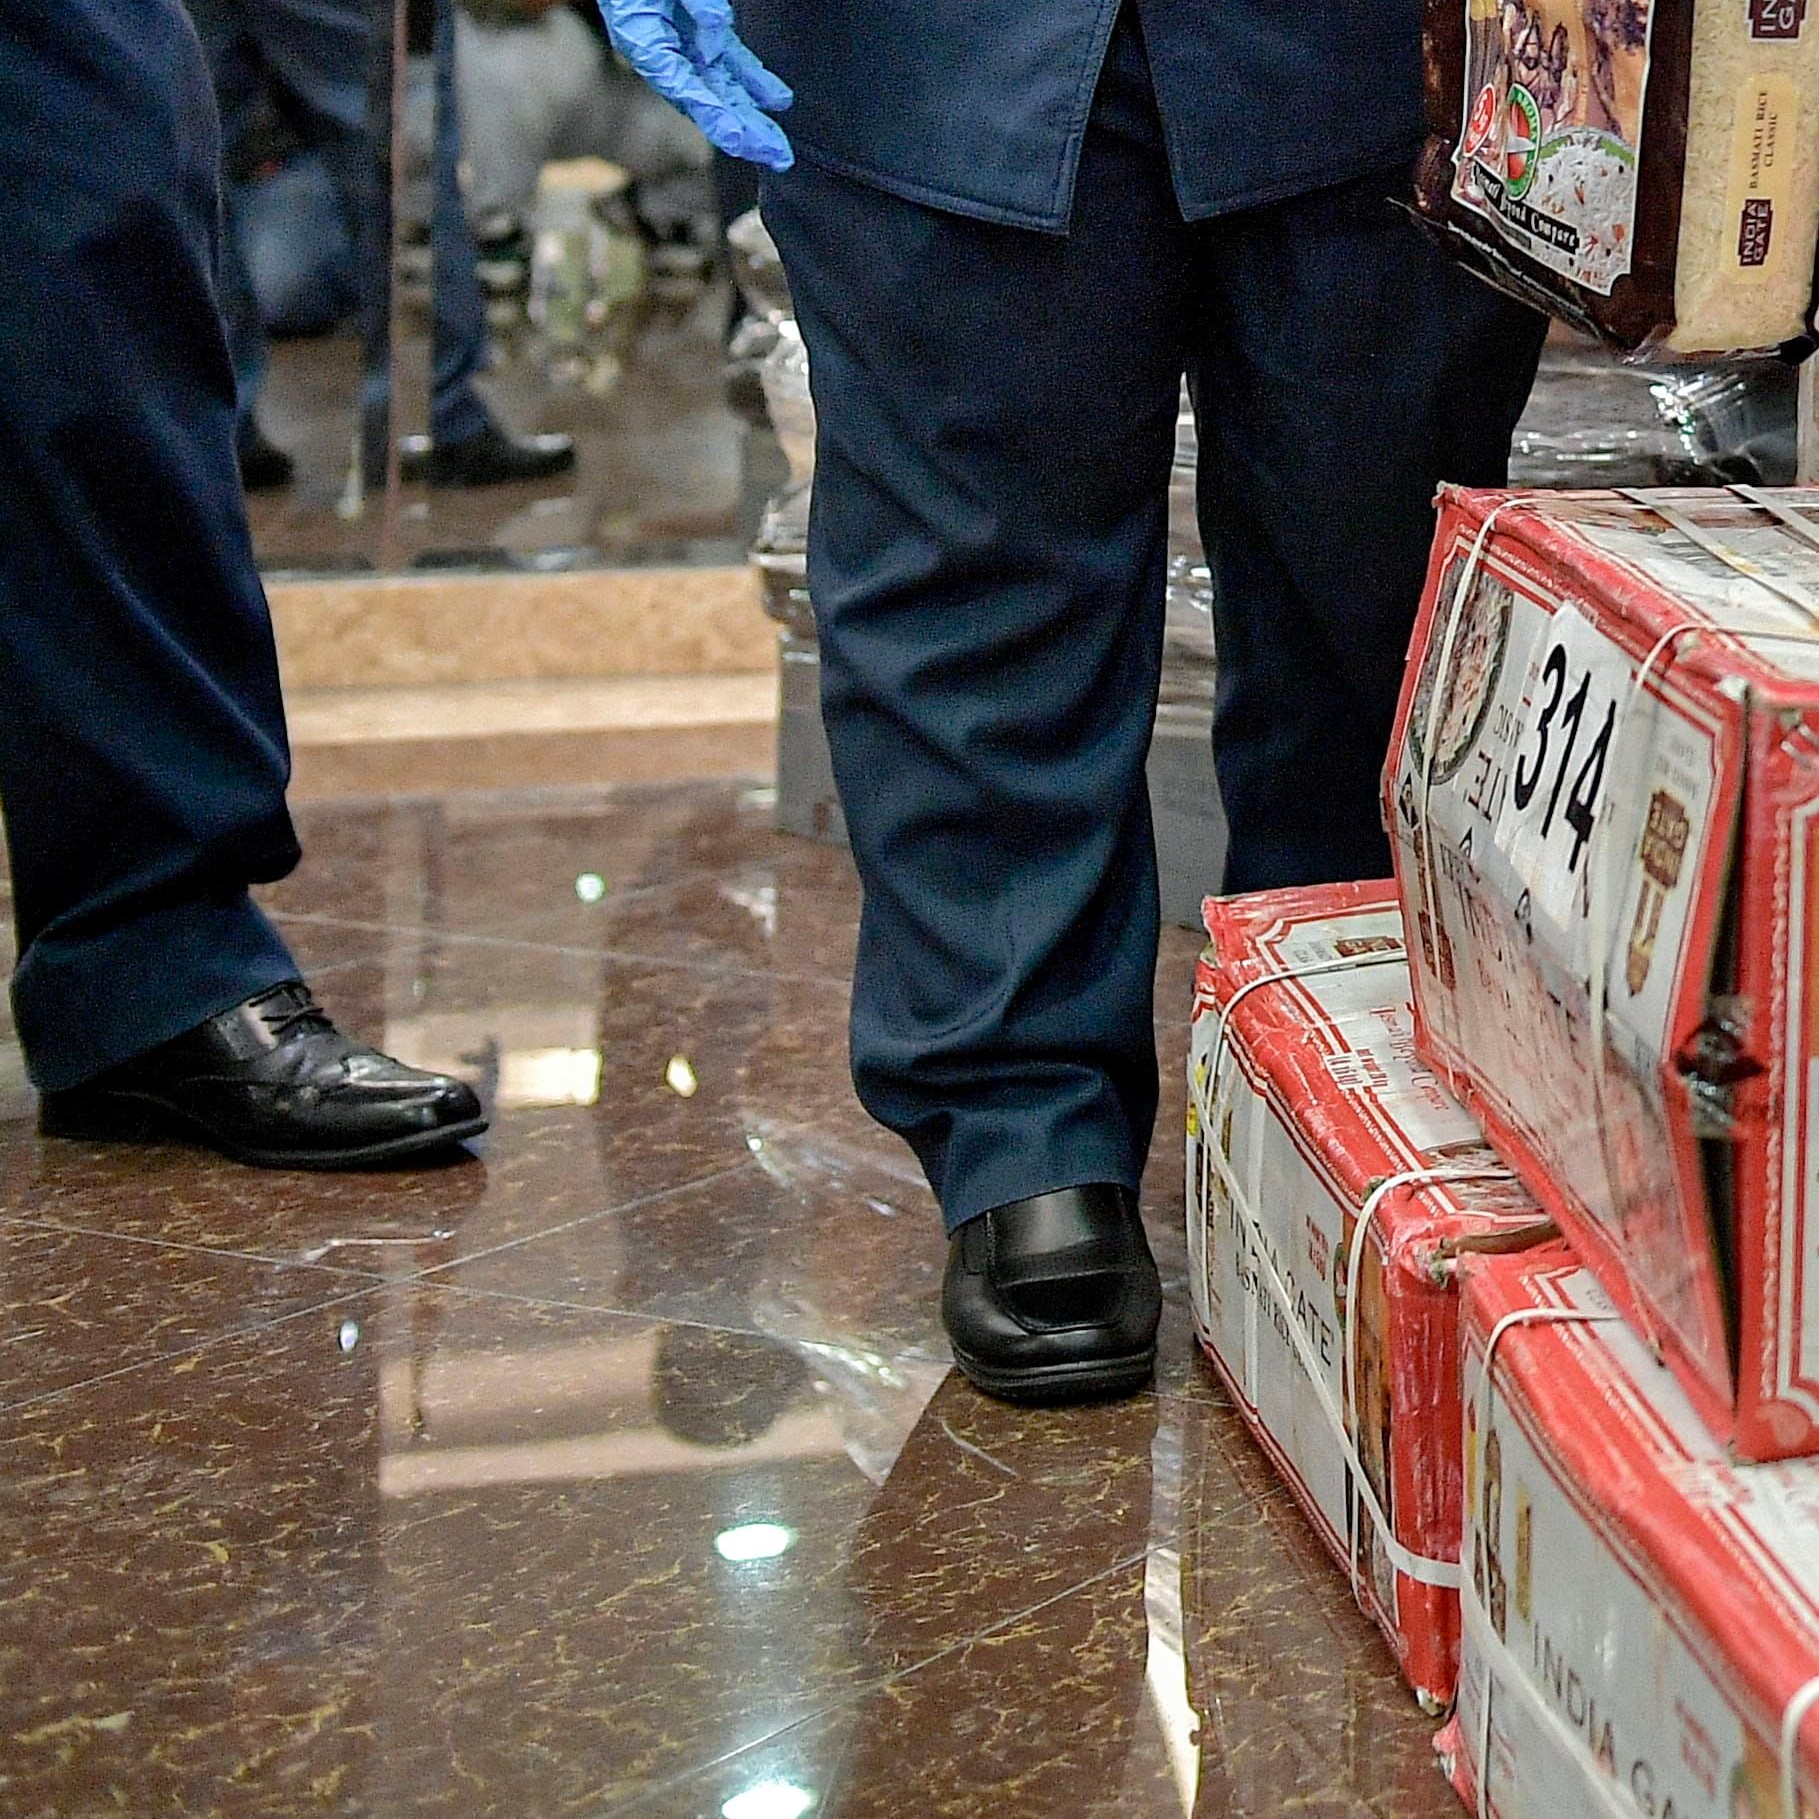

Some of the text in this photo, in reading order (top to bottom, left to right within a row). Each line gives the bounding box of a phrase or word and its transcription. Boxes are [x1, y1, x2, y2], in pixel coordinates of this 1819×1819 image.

[1749, 92, 1769, 189] BASMATI RICE
[1764, 113, 1778, 167] CLASSIC
[1742, 202, 1758, 263] INDIA
[1753, 203, 1770, 261] GATE
[1514, 643, 1617, 875] 314
[1533, 1621, 1618, 1779] INDIA
